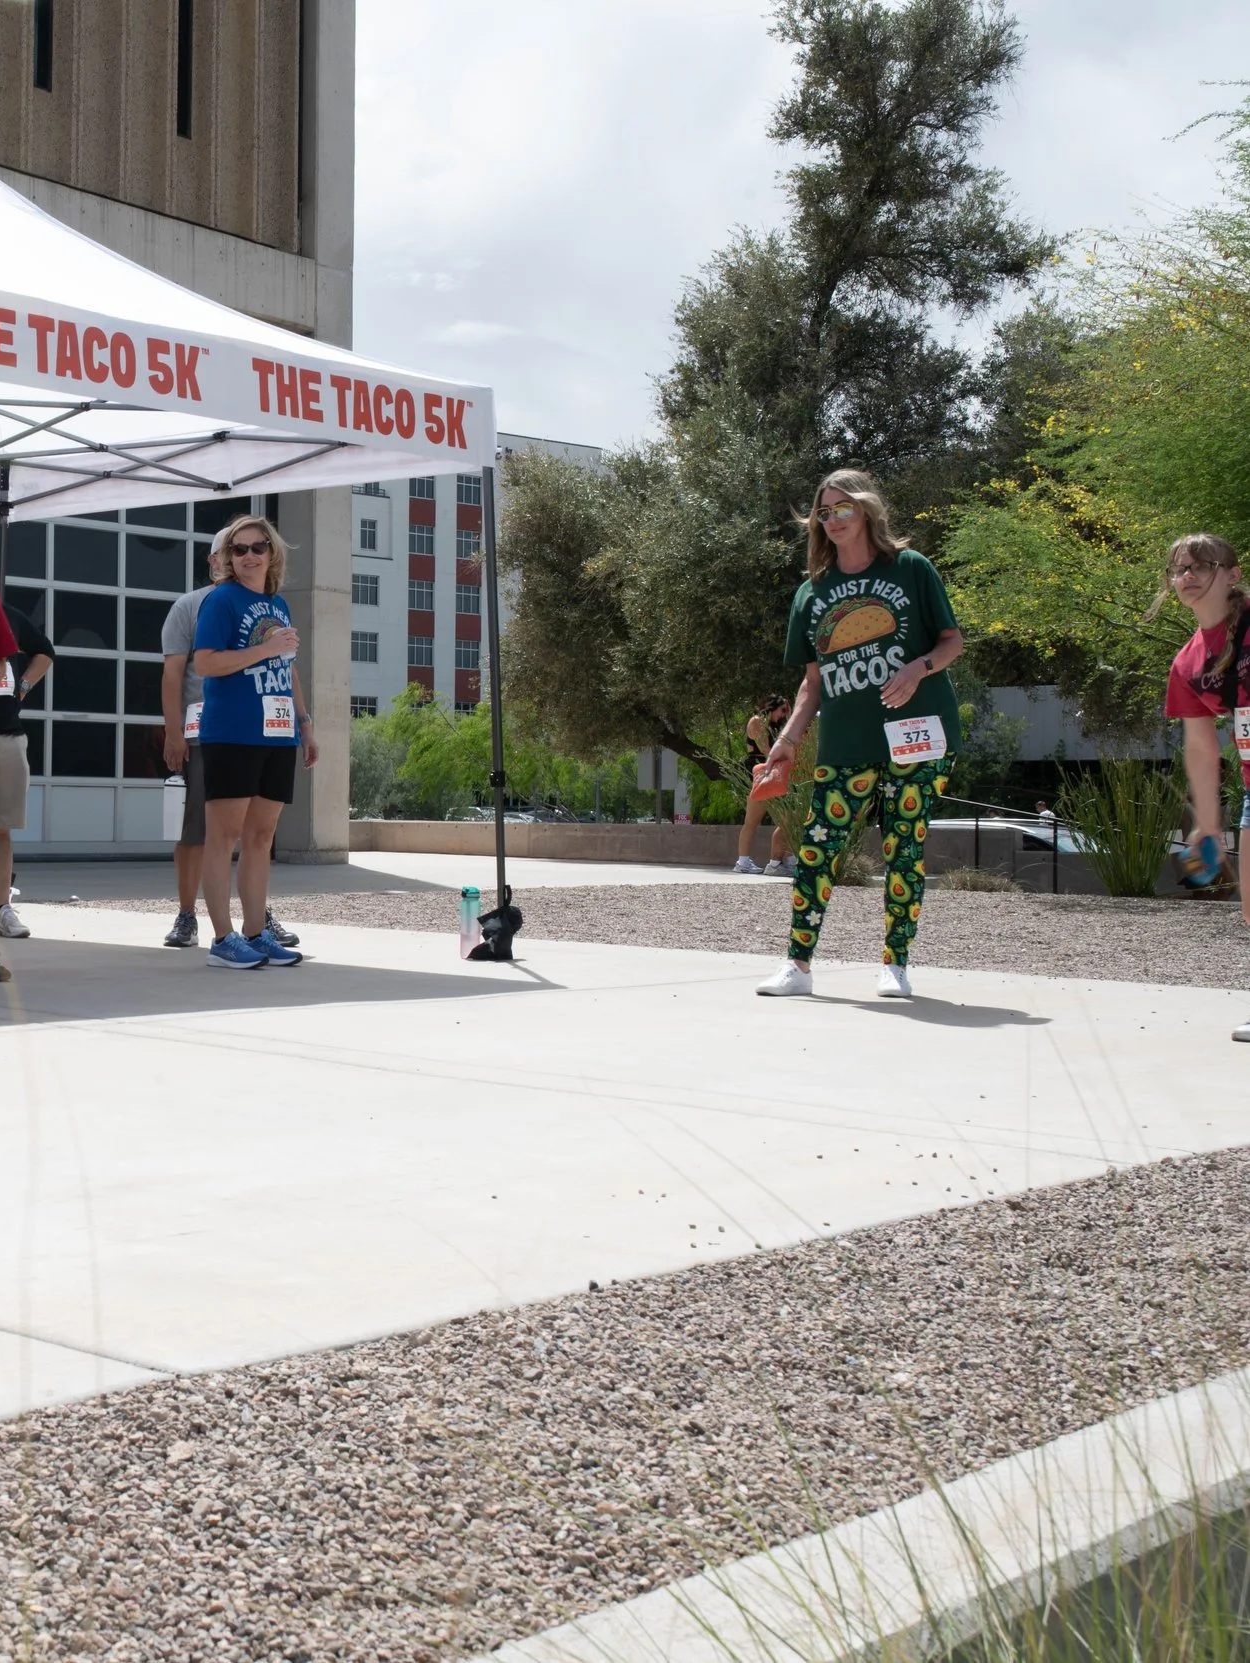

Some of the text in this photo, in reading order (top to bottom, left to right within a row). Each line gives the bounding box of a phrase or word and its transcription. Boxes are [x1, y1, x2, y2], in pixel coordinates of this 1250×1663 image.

[28, 313, 136, 388] TACO
[252, 357, 324, 423] THE
[330, 374, 416, 440] TACO
[828, 578, 870, 603] JUST
[871, 578, 911, 610] HERE
[238, 601, 291, 635] I'M JUST HER
[837, 642, 881, 666] FOR THE
[243, 666, 292, 694] TACO
[819, 645, 905, 698] TACOS
[275, 707, 291, 719] 374
[903, 730, 931, 744] 373
